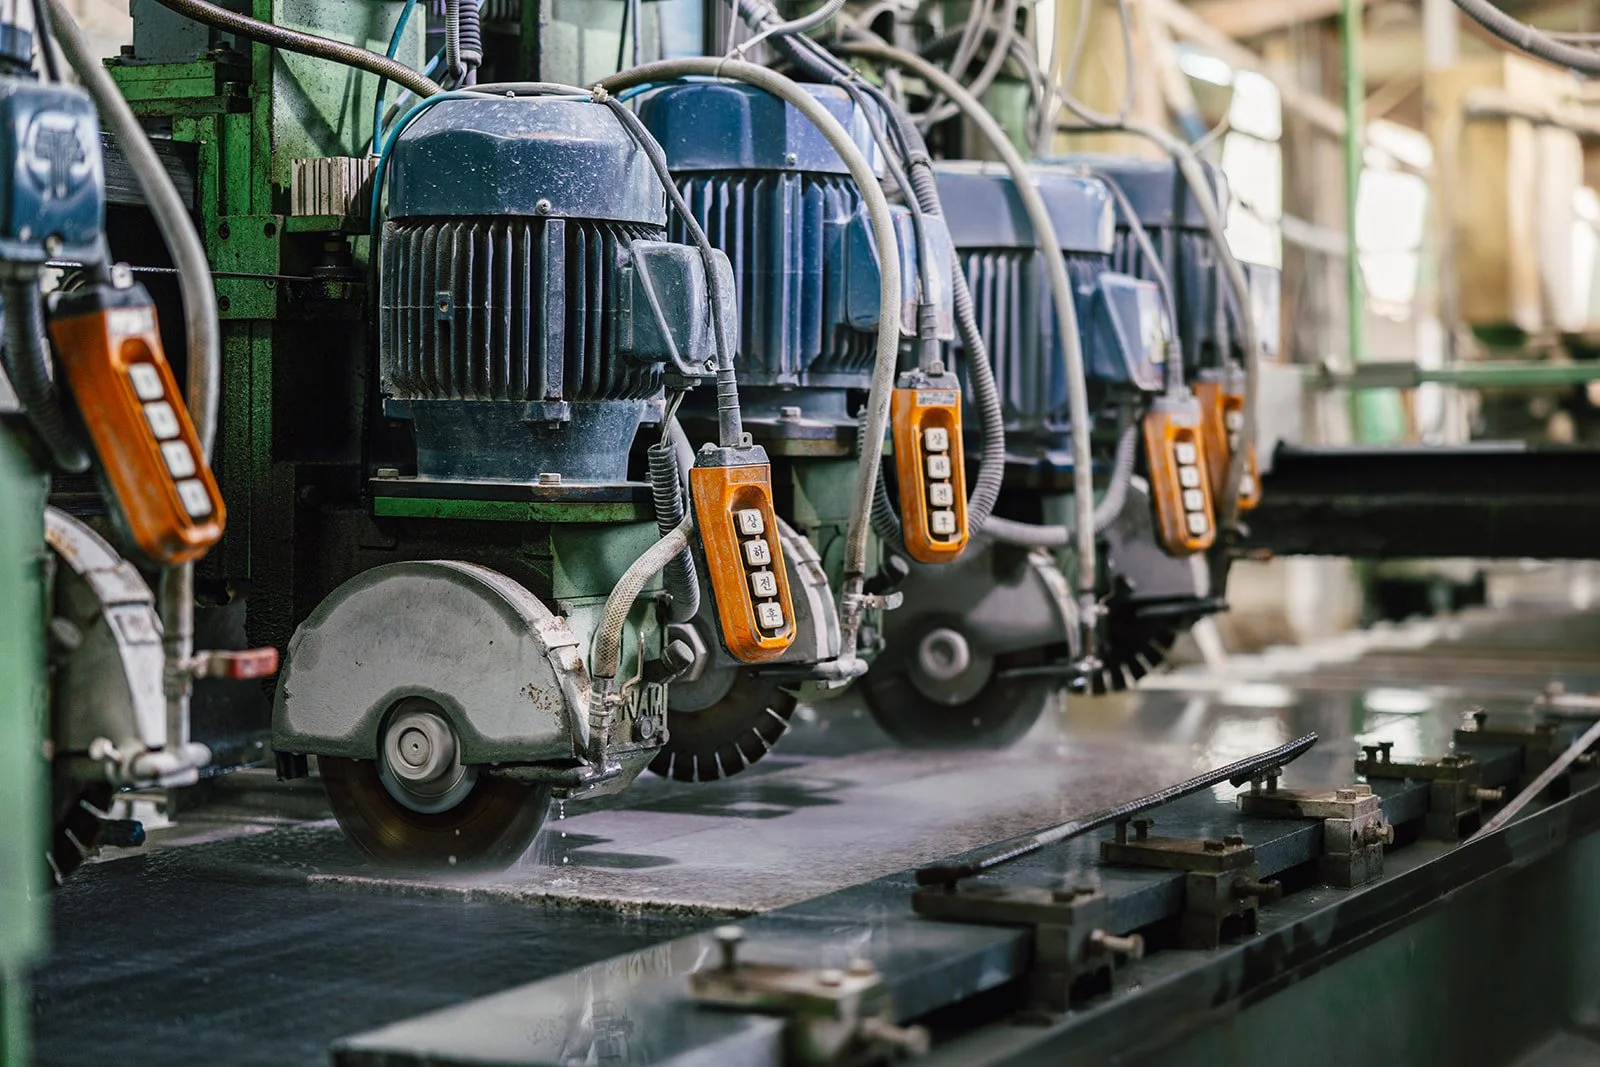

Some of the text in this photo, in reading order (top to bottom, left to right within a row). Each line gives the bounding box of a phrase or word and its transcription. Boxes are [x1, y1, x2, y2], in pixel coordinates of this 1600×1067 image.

[748, 514, 758, 529] 상
[753, 545, 765, 560] 하
[760, 576, 772, 591] 전
[766, 608, 778, 622] 후
